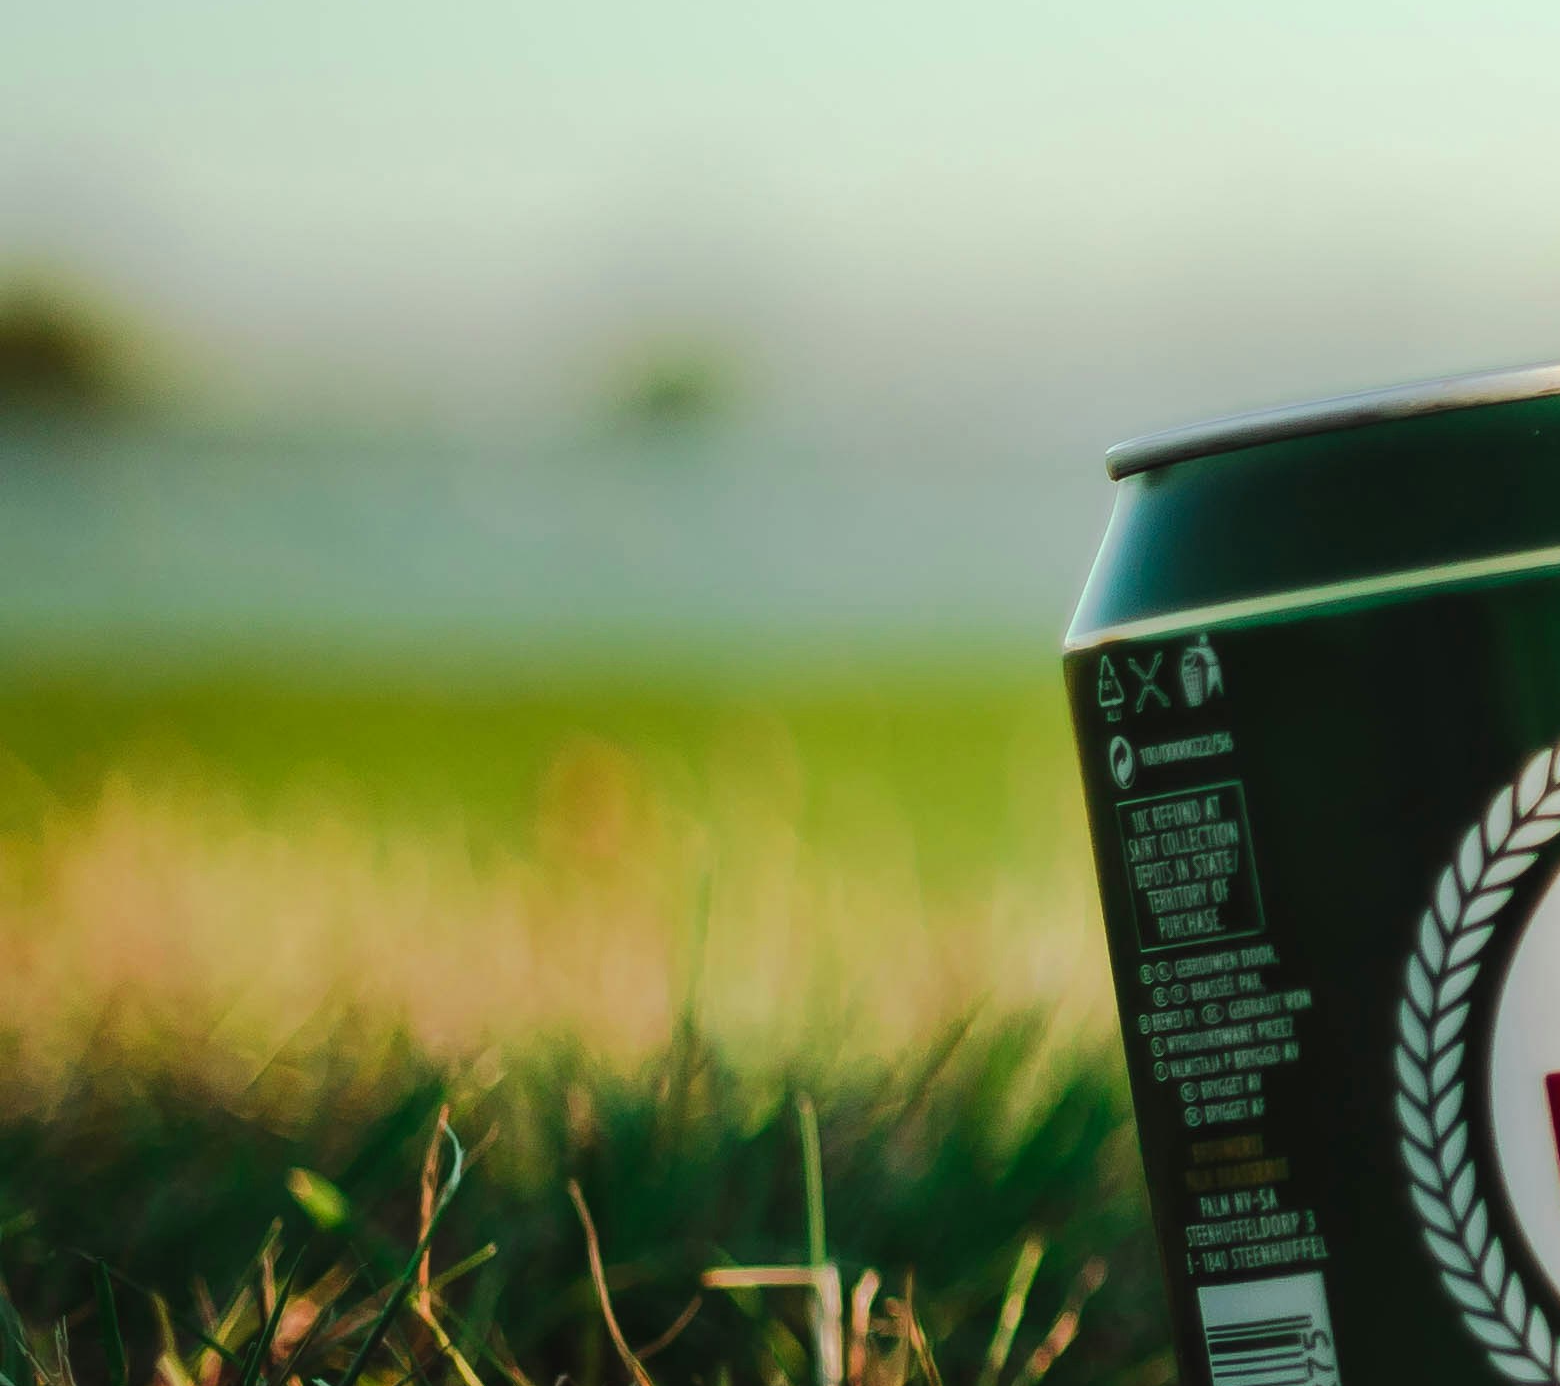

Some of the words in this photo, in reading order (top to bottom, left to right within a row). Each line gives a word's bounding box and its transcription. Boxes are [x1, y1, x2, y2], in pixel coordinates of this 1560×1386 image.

[1152, 799, 1201, 830] REFUND
[1205, 795, 1221, 819] AT
[1160, 820, 1239, 856] COLLECTION
[1135, 861, 1174, 889] DEPOTS
[1176, 859, 1190, 882] IN
[1147, 882, 1208, 914] TERRITORY
[1211, 878, 1230, 903] OF
[1200, 1193, 1232, 1218] PALM
[1233, 1187, 1279, 1213] NV-SA
[1185, 1212, 1300, 1248] STEENHUFFELDORP
[1230, 1235, 1330, 1270] STEENHUFFEL
